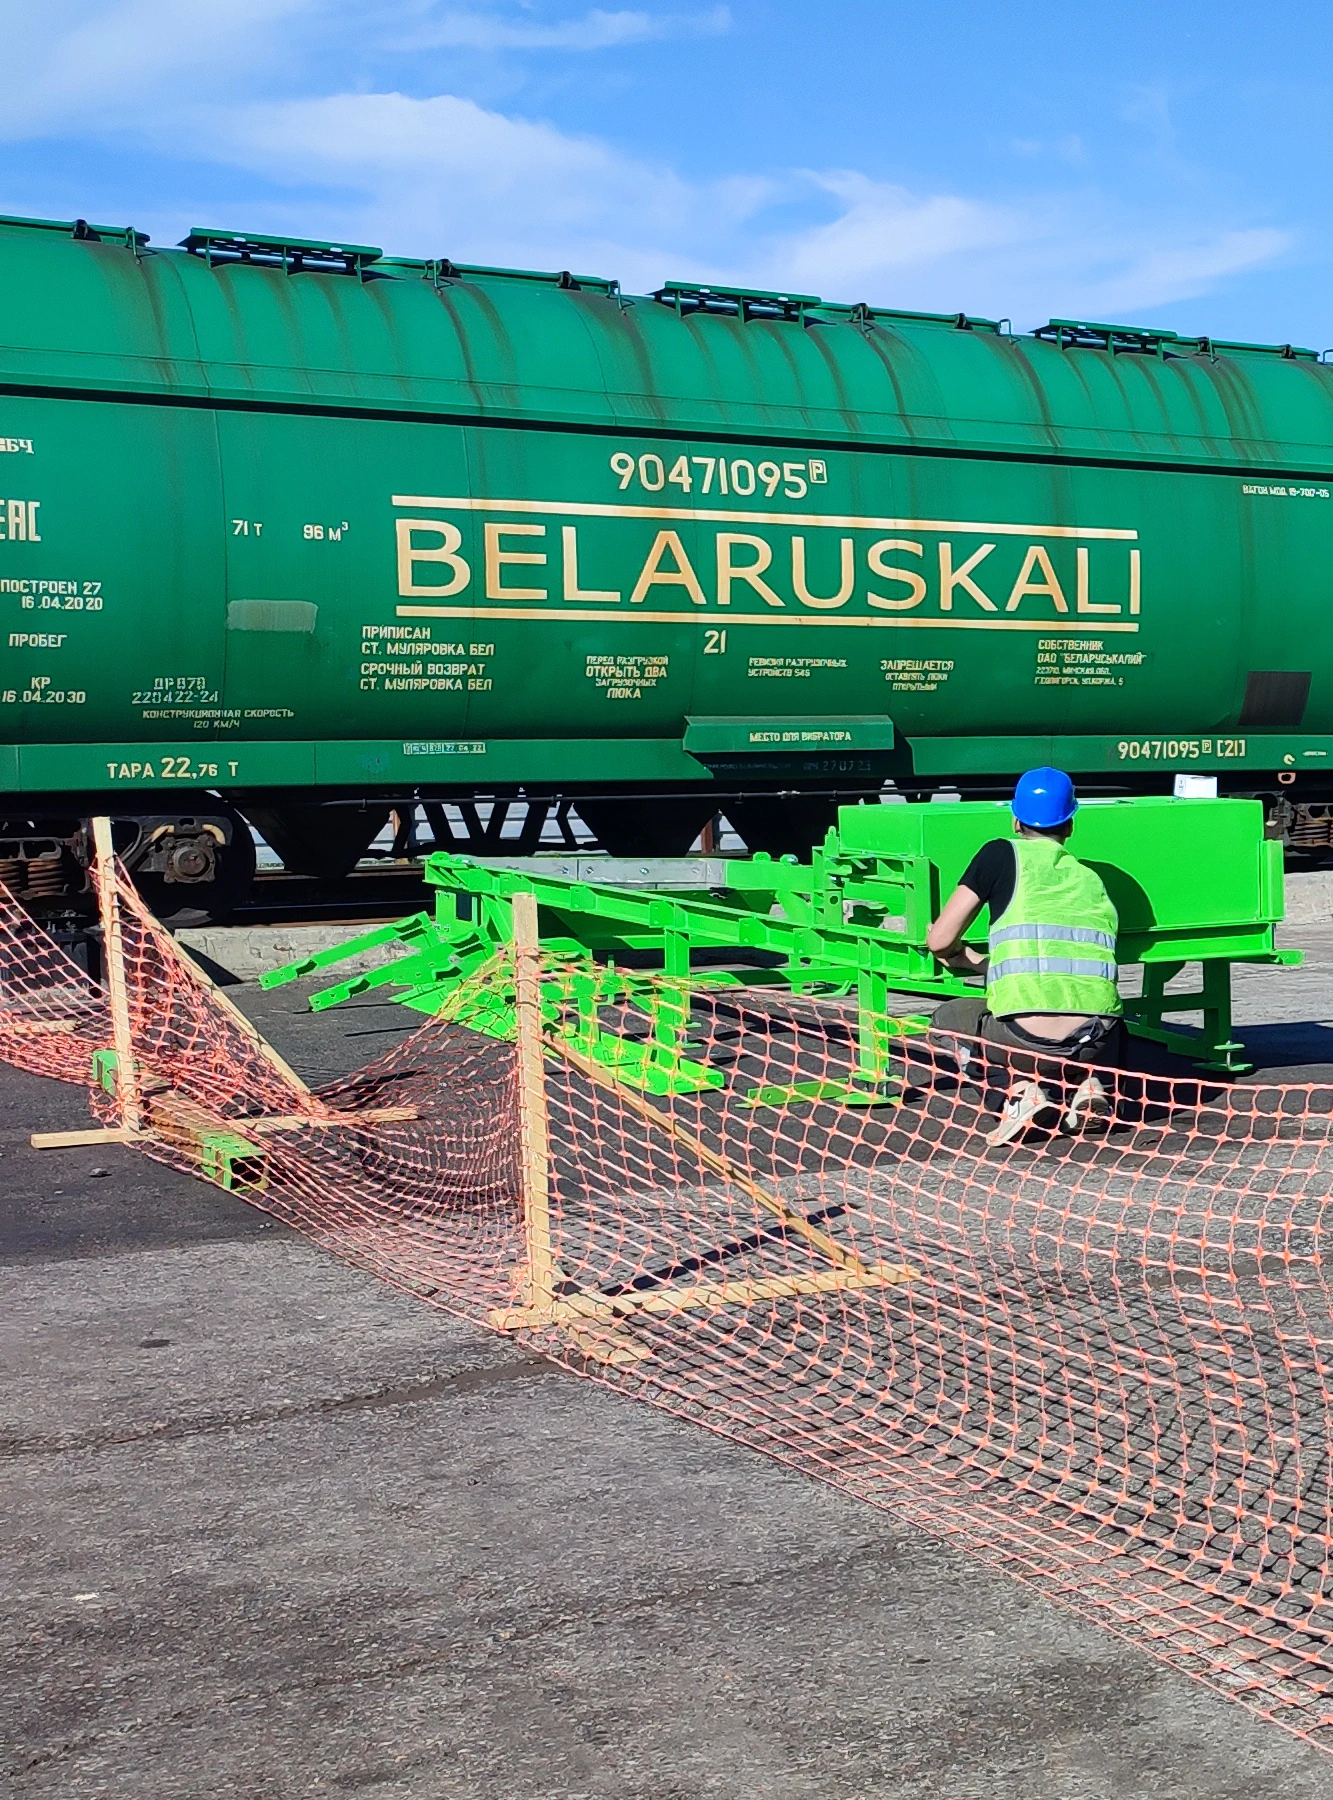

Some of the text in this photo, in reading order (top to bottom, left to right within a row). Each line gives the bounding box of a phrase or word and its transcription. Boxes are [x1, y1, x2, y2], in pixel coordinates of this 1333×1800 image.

[610, 452, 808, 499] 90471095
[231, 519, 249, 536] 71
[396, 519, 1141, 615] BELARUSKALI
[0, 579, 102, 595] ПОСТРОЕН 27
[21, 595, 103, 611] 16.04.2020
[9, 632, 68, 648] ПРОБЕГ
[361, 624, 431, 640] ПРИПИСАН
[361, 641, 495, 656] СТ. МУЛЯРОВКА БЕЛ
[703, 629, 727, 655] 21
[1037, 639, 1105, 651] СОБСТВЕННИК
[1036, 653, 1058, 664] ОАО
[360, 660, 486, 676] СРОЧНЫЙ ВОЗВРАТ
[585, 665, 668, 678] ОТКРЫТЬ ДВА
[31, 676, 51, 691] КР
[360, 677, 493, 692] СТ. МУЛЯРОВКА БЕЛ
[2, 690, 87, 704] 16.04.2030
[606, 687, 642, 699] ЛЮКА
[244, 708, 295, 718] СКОРОСТЬ
[1118, 741, 1200, 760] 90471095
[107, 762, 155, 780] ТАРА
[160, 757, 218, 780] 22,76
